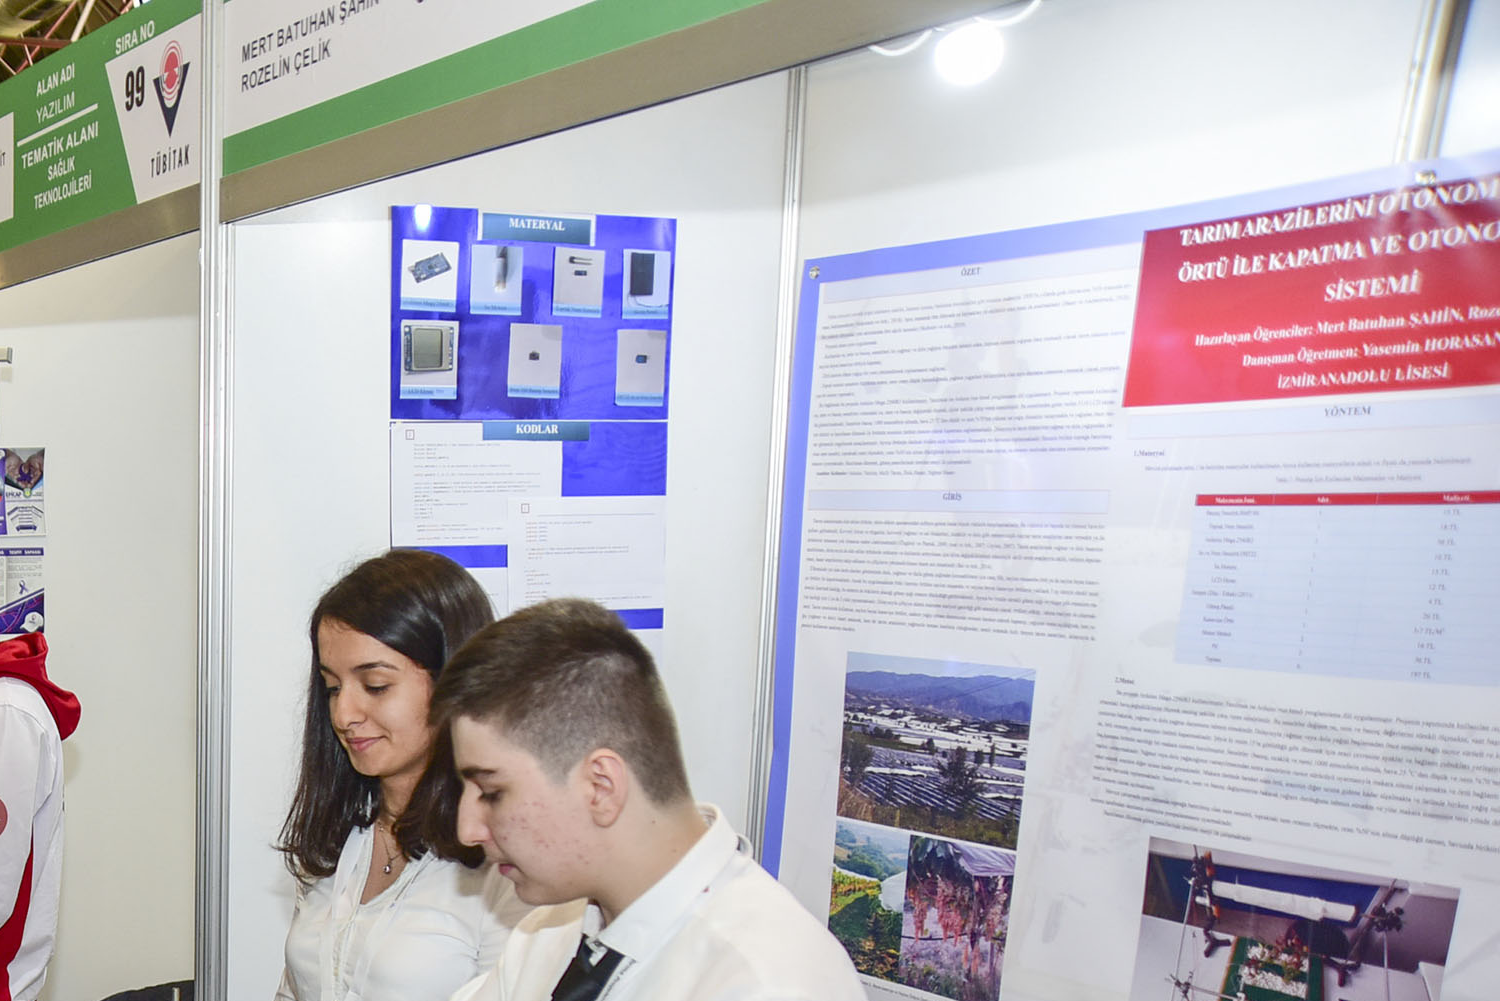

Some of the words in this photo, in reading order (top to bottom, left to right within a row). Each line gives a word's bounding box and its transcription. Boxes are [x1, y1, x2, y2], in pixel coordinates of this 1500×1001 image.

[115, 31, 139, 55] SIRA
[140, 20, 156, 39] NO
[241, 32, 274, 63] MERT
[277, 6, 335, 46] BATUHAN
[36, 71, 59, 96] ALAN
[59, 63, 75, 84] ADI
[241, 54, 291, 93] ROZELİN
[294, 38, 332, 75] ÇELİK
[125, 65, 145, 112] 99
[36, 91, 76, 124] YAZILIM
[21, 136, 64, 169] TEMATİK
[66, 121, 99, 150] ALANI
[150, 144, 190, 178] TÜBİTAK
[47, 156, 76, 181] SAĞLIK
[34, 169, 92, 209] TEKNOLOJİLERİ
[509, 216, 566, 232] MATERYAL
[1179, 221, 1240, 247] TARIM
[1240, 193, 1377, 238] ARAZİLERİNİ
[960, 265, 982, 277] ÖZET
[1177, 256, 1230, 283] ÖRTÜ
[1232, 251, 1265, 278] İLE
[1267, 239, 1364, 272] KAPATMA
[1369, 234, 1402, 257] VE
[1323, 268, 1424, 303] SİSTEMİ
[1195, 329, 1252, 348] Hazırlayan
[1253, 323, 1313, 344] Öğrenciler:
[1316, 318, 1346, 335] Mert
[1348, 315, 1406, 333] Batuhan
[1242, 351, 1295, 368] Danışman
[1297, 347, 1359, 365] Öğretmen:
[1361, 341, 1421, 358] Yasemin
[1277, 370, 1316, 390] İZMİR
[1316, 368, 1392, 387] ANADOLU
[1394, 361, 1450, 382] LİSESİ
[1323, 405, 1372, 417] YÖNTEM
[515, 422, 560, 436] KODLAR
